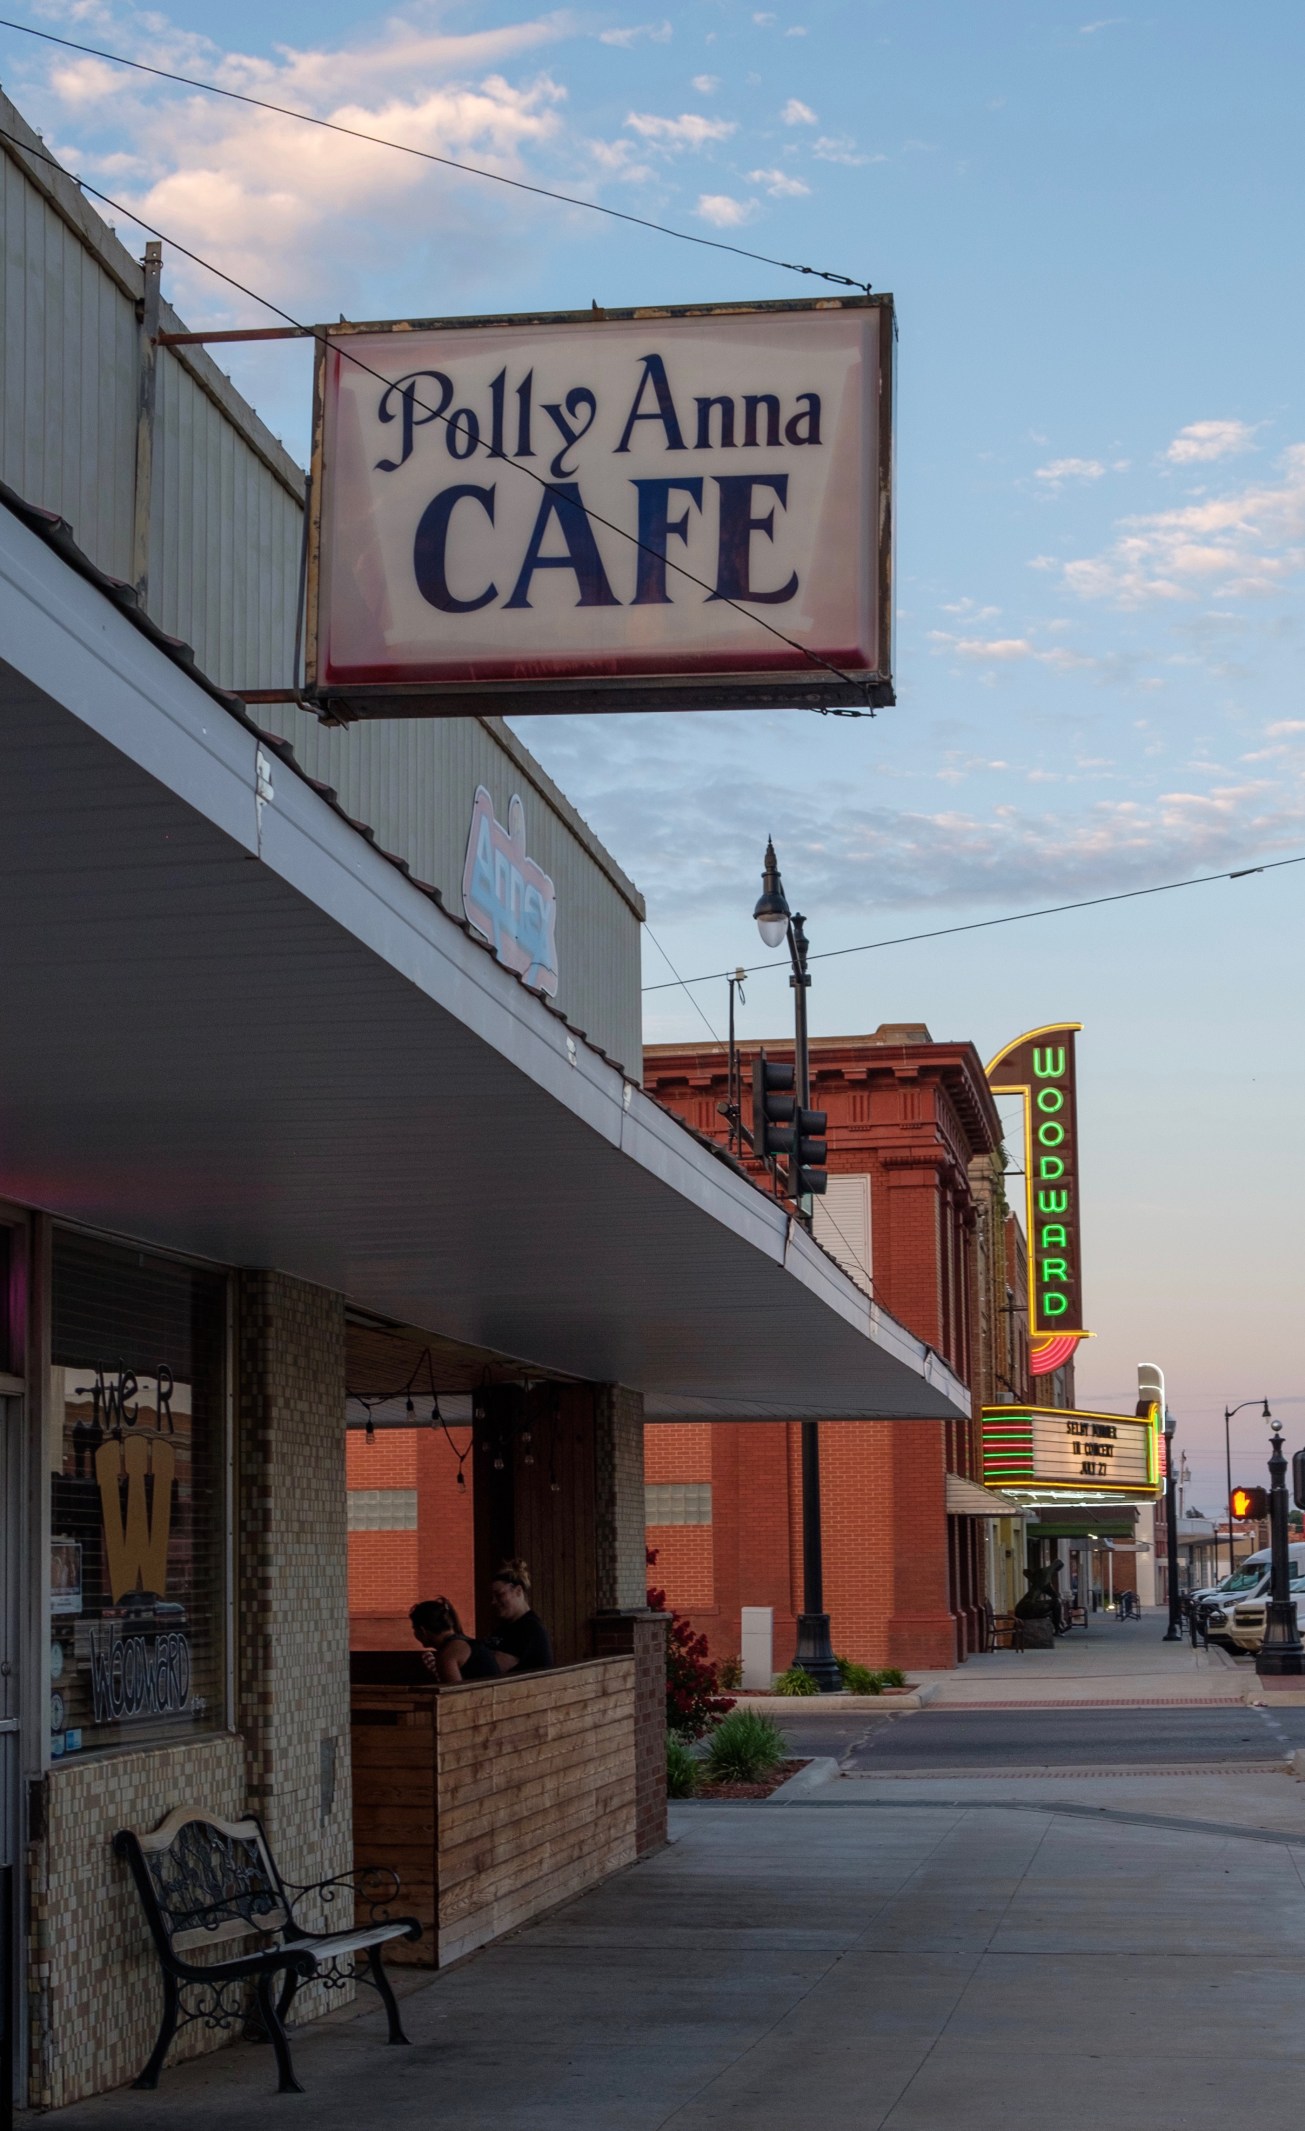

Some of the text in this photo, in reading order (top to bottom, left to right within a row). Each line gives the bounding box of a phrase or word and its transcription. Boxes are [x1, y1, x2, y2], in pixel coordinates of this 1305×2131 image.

[374, 353, 823, 478] Polly Anna
[413, 473, 799, 613] CAFE
[1032, 1046, 1068, 1317] WOODWARD
[98, 1358, 175, 1434] We R
[1073, 1441, 1114, 1457] IN CONCERT
[1080, 1461, 1096, 1475] JULY
